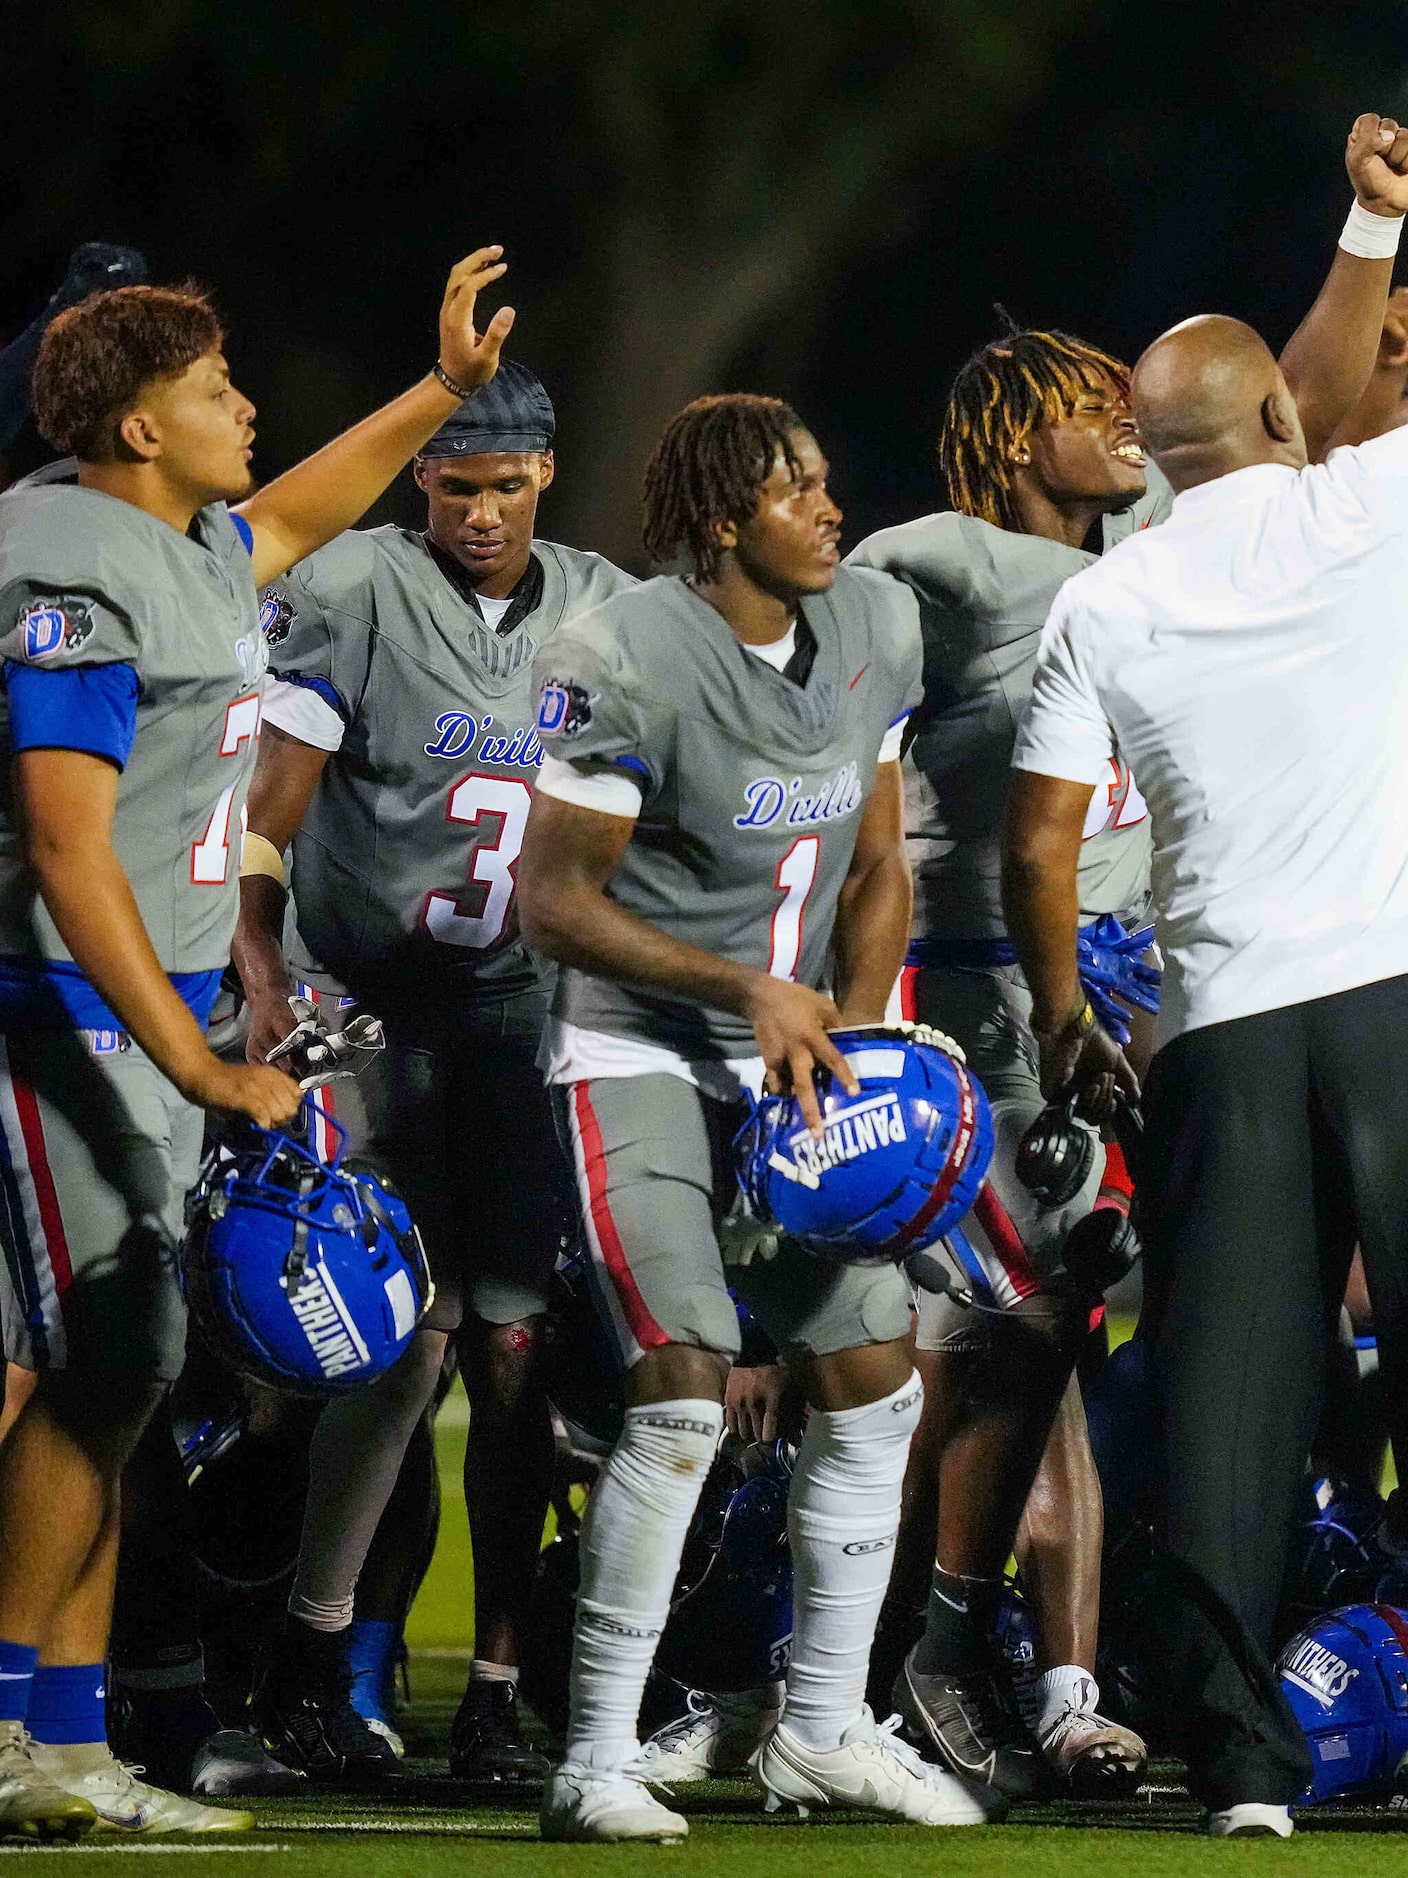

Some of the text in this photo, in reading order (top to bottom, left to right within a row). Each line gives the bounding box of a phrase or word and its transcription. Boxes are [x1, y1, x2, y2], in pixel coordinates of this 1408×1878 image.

[24, 609, 66, 660] D
[536, 685, 571, 736] D
[421, 771, 532, 949] 3
[767, 833, 821, 983] 1
